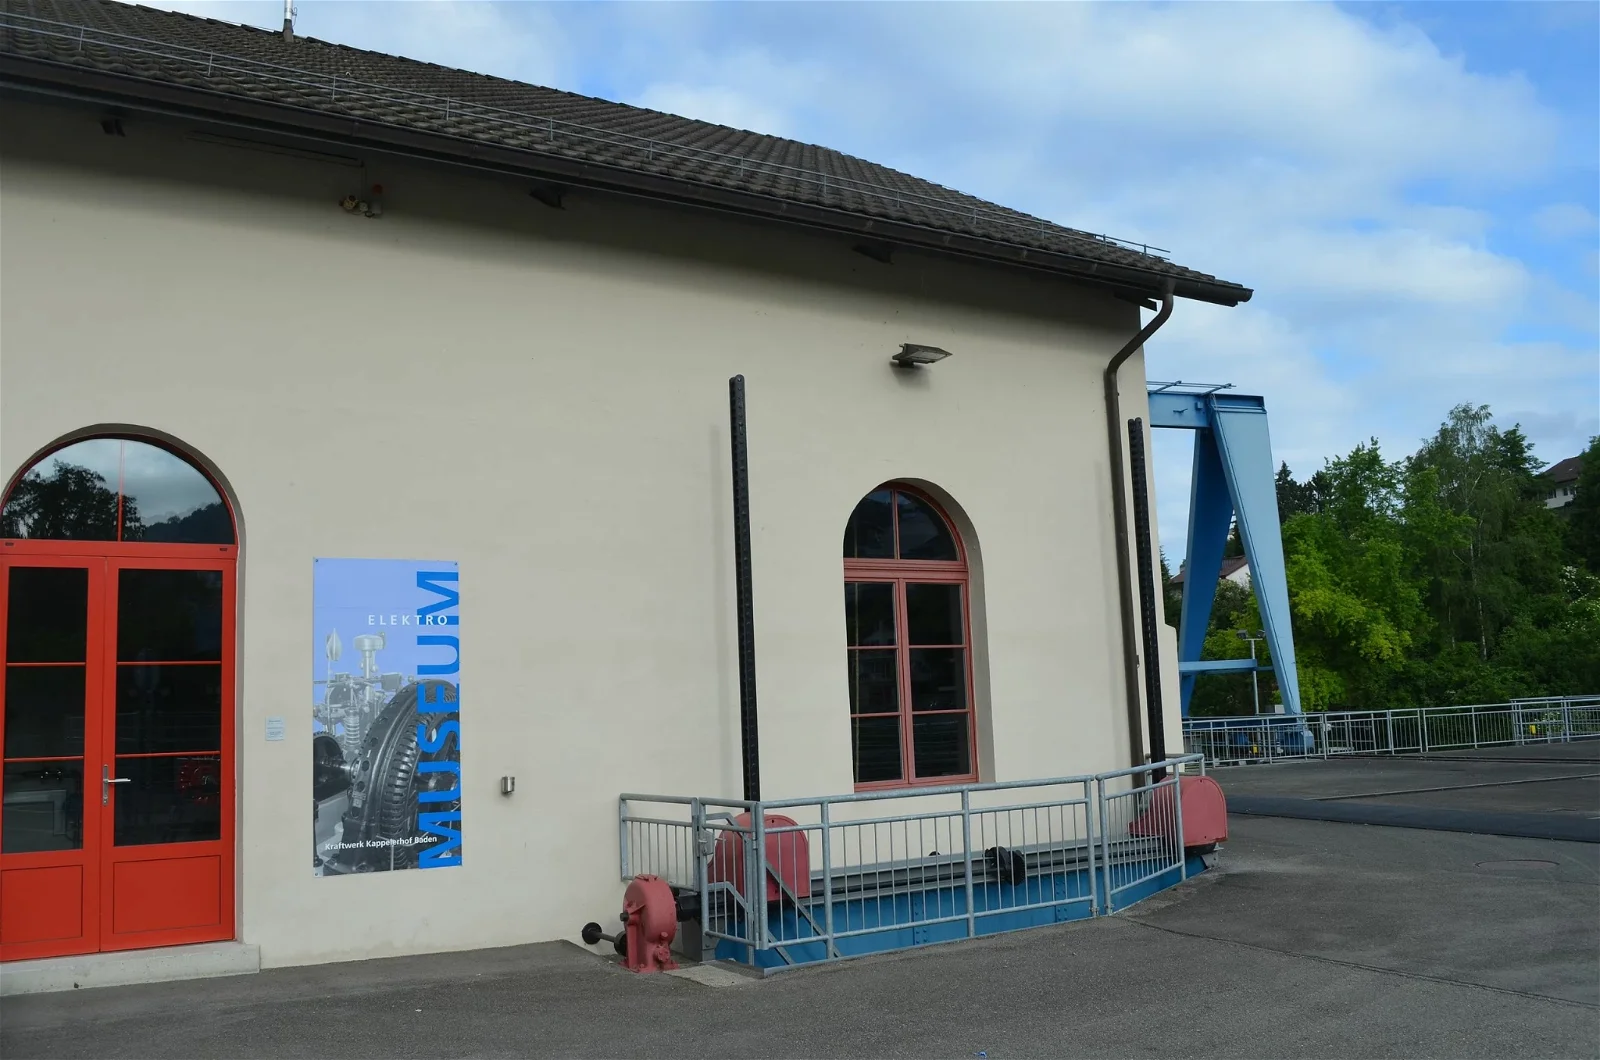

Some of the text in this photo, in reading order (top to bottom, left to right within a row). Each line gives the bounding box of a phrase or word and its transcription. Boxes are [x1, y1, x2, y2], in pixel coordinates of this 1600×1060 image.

[368, 614, 448, 626] ELEKTRO
[417, 571, 462, 869] MUSEUM
[324, 835, 438, 850] Kraftwerk Kappelerhof Baden
